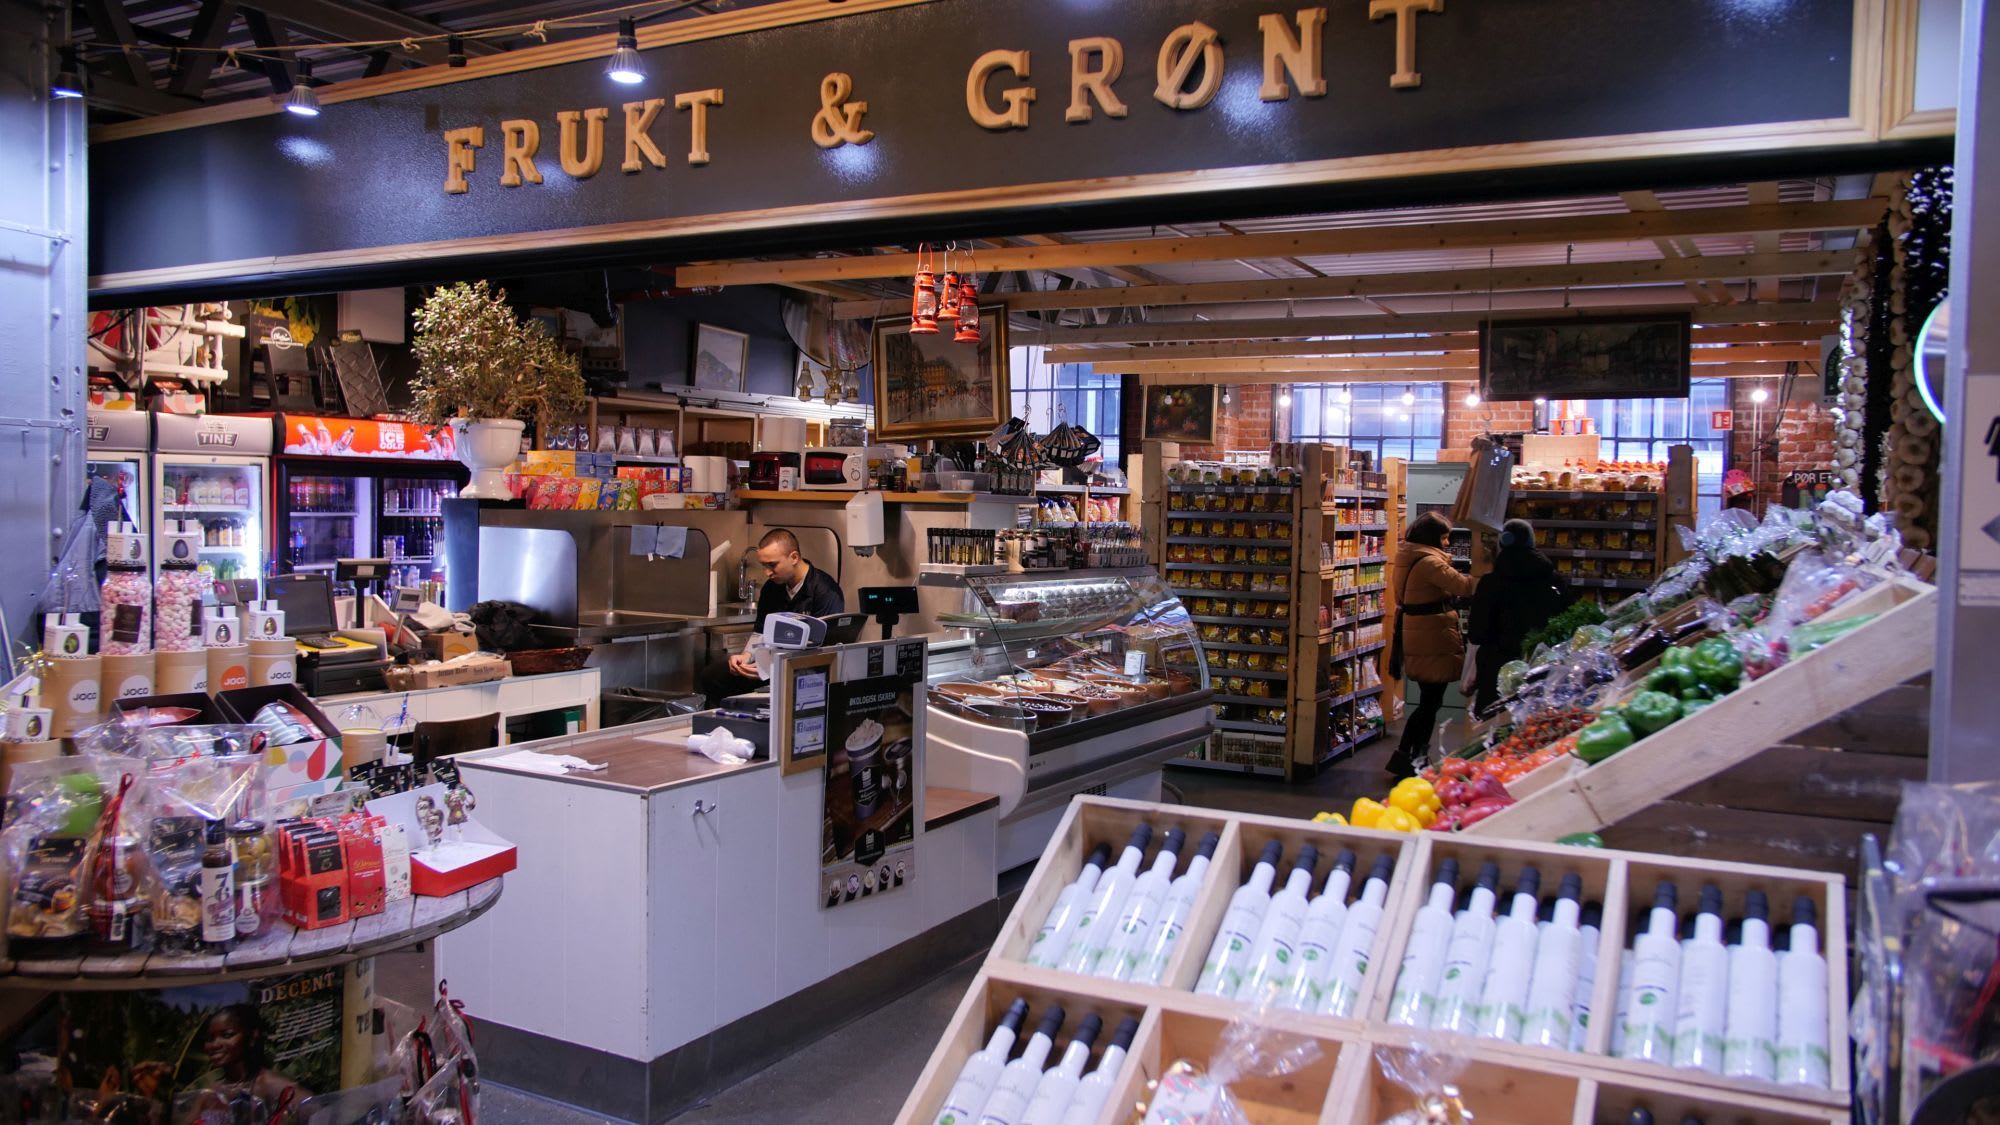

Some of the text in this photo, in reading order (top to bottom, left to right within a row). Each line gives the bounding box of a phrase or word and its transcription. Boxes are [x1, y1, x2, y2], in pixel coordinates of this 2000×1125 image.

[444, 0, 1444, 194] FRUKT & GRØNT
[200, 433, 234, 445] TINE
[380, 432, 405, 443] ICE
[270, 671, 292, 680] JOCO
[223, 677, 246, 686] JOCO
[73, 692, 97, 702] JOCO
[123, 687, 149, 697] JOCO
[260, 971, 336, 1004] DECENT
